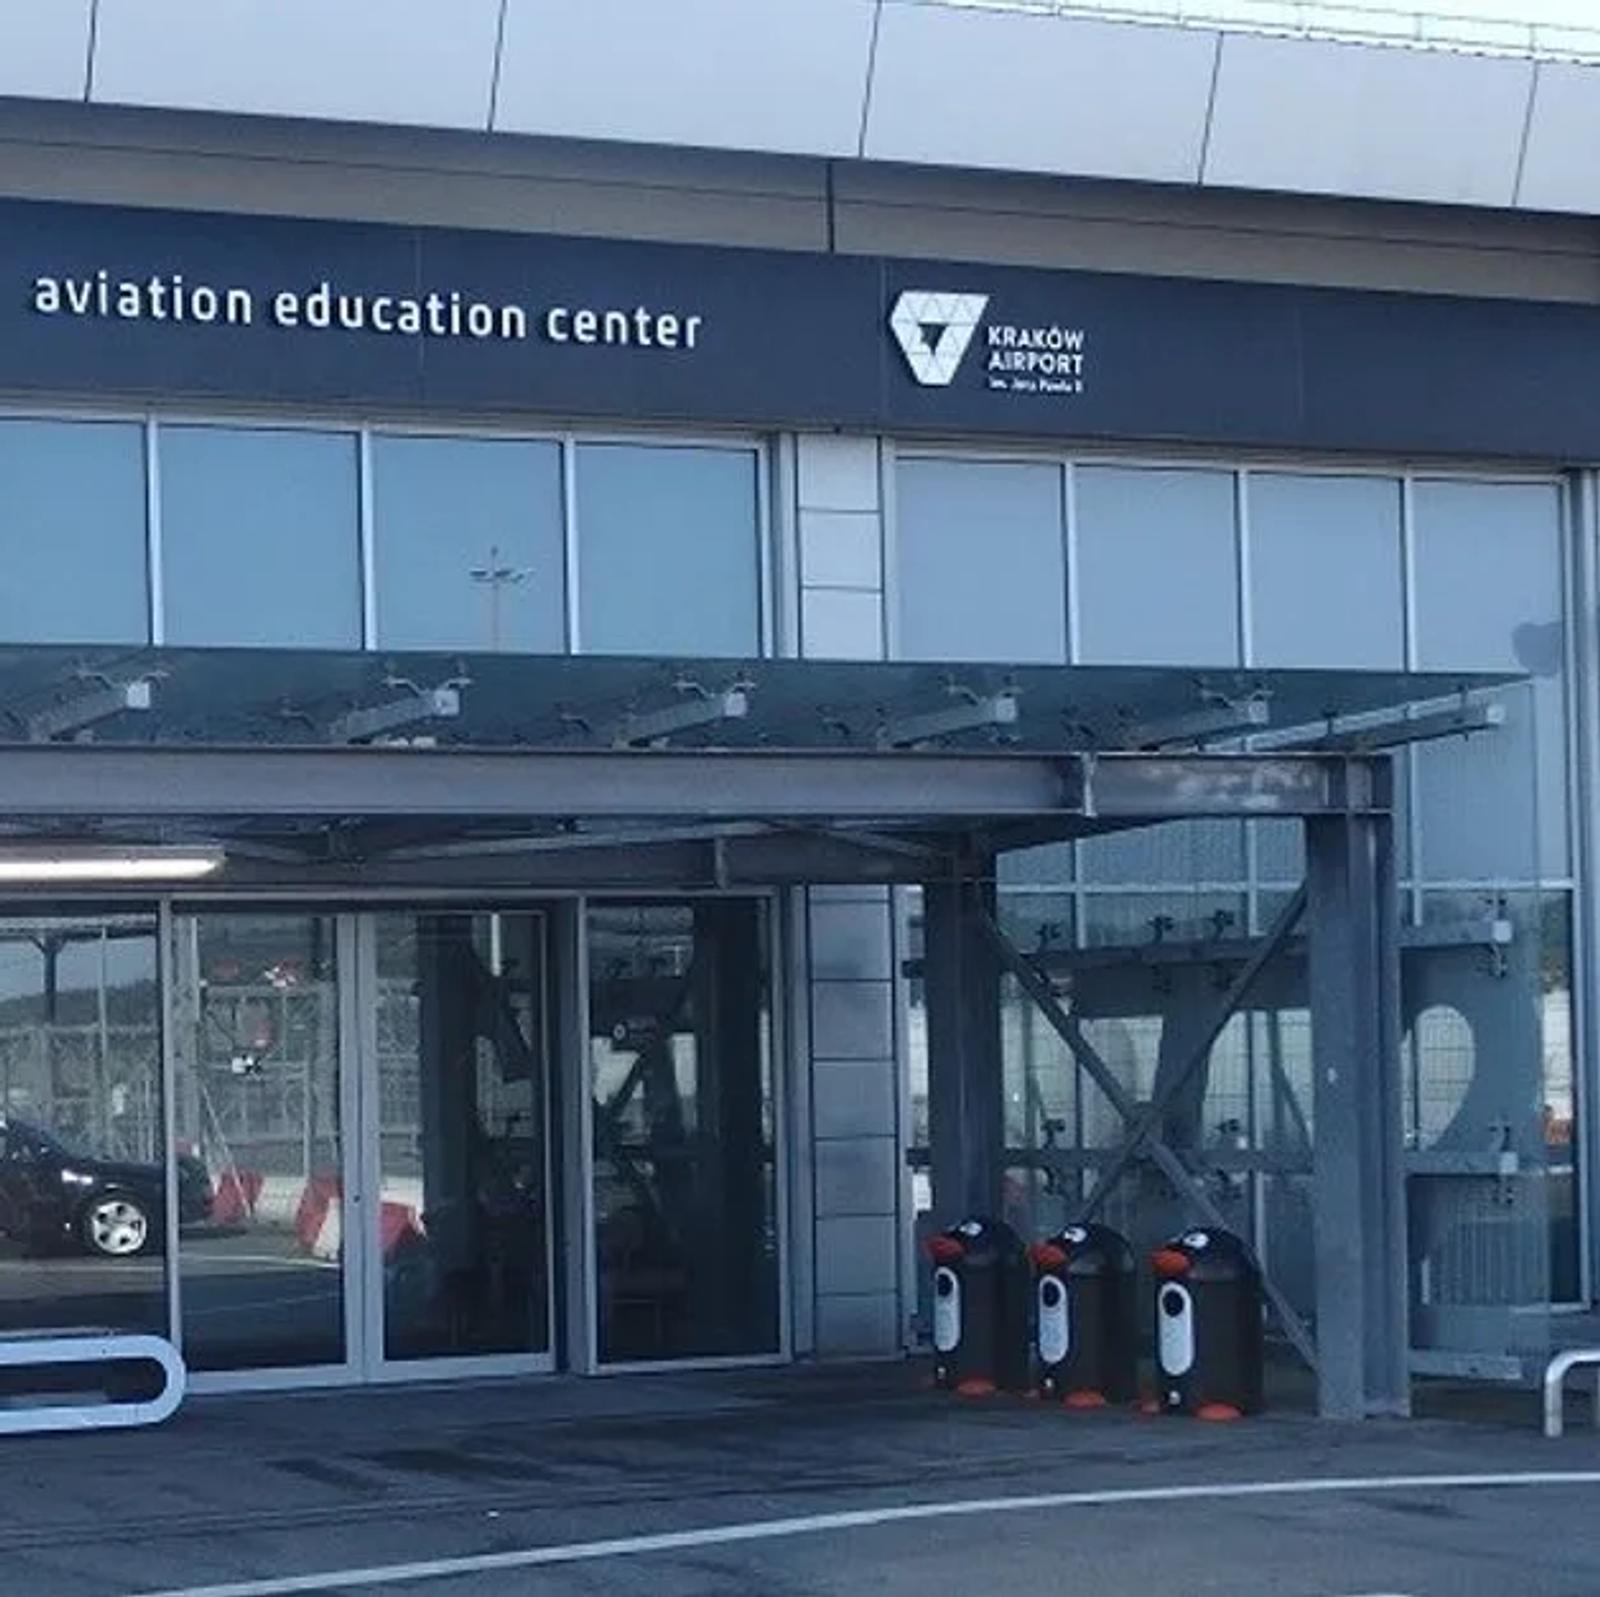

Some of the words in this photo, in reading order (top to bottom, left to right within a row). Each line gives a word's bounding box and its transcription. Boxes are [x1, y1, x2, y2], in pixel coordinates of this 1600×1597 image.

[35, 269, 253, 324] aviation
[275, 282, 526, 339] education
[547, 306, 703, 349] center
[988, 351, 1084, 375] AIRPORT
